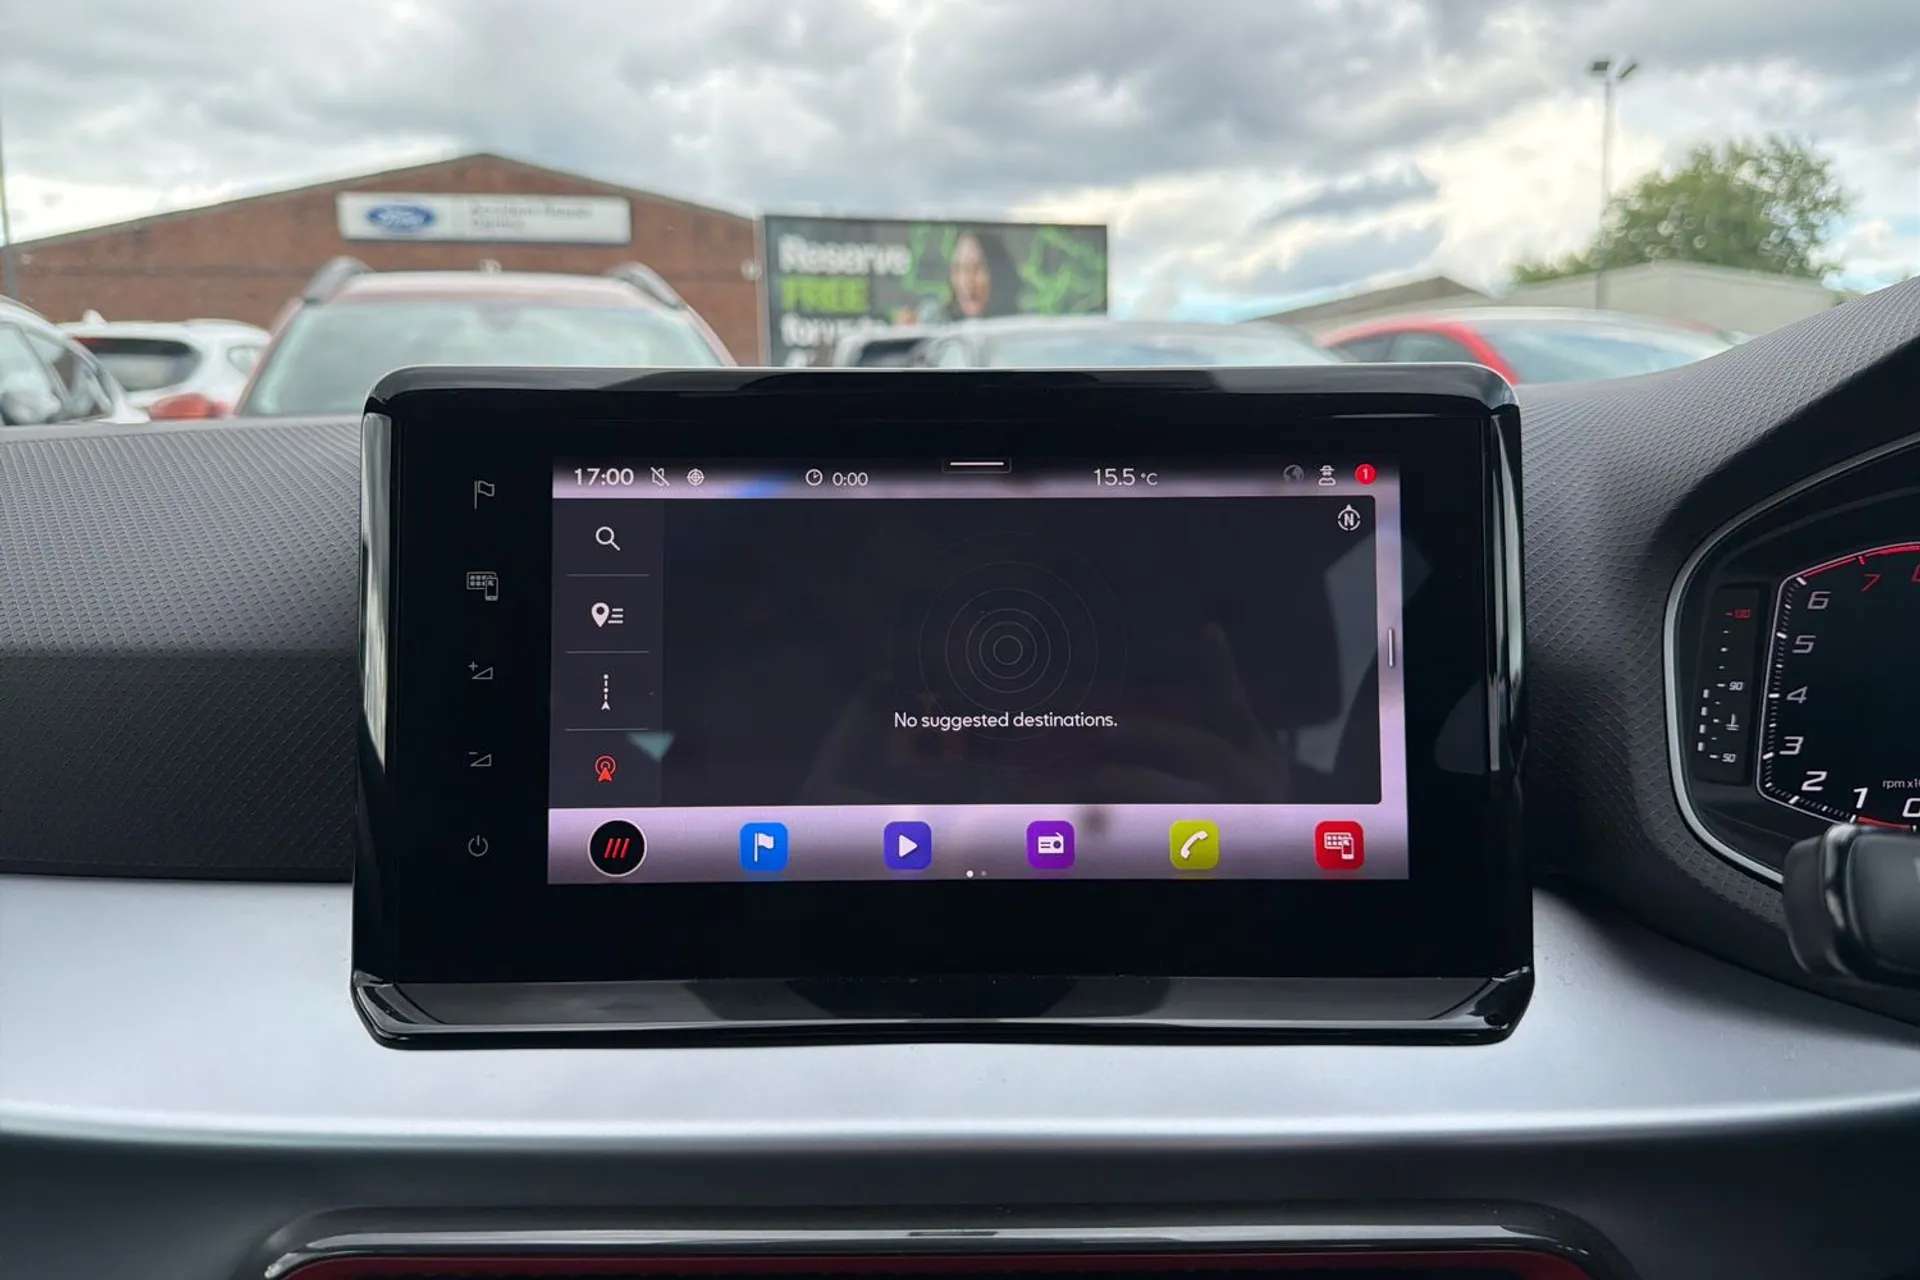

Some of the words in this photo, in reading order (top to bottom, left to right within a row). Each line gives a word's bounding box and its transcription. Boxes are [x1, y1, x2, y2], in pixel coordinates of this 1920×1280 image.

[778, 233, 911, 275] Reserve
[781, 276, 869, 313] FREE
[574, 468, 635, 486] 17:00
[832, 472, 868, 486] 0:00
[1094, 468, 1136, 486] 15.5
[1344, 513, 1356, 527] N
[1861, 573, 1880, 592] 7
[1807, 591, 1831, 610] 6
[1792, 635, 1816, 654] 5
[1786, 686, 1808, 704] 4
[894, 711, 918, 728] No
[921, 712, 1009, 731] suggested
[1013, 711, 1118, 728] destinations.
[1779, 736, 1804, 755] 3
[1801, 771, 1827, 791] 2
[1882, 780, 1905, 790] rpm
[1853, 787, 1868, 809] 1
